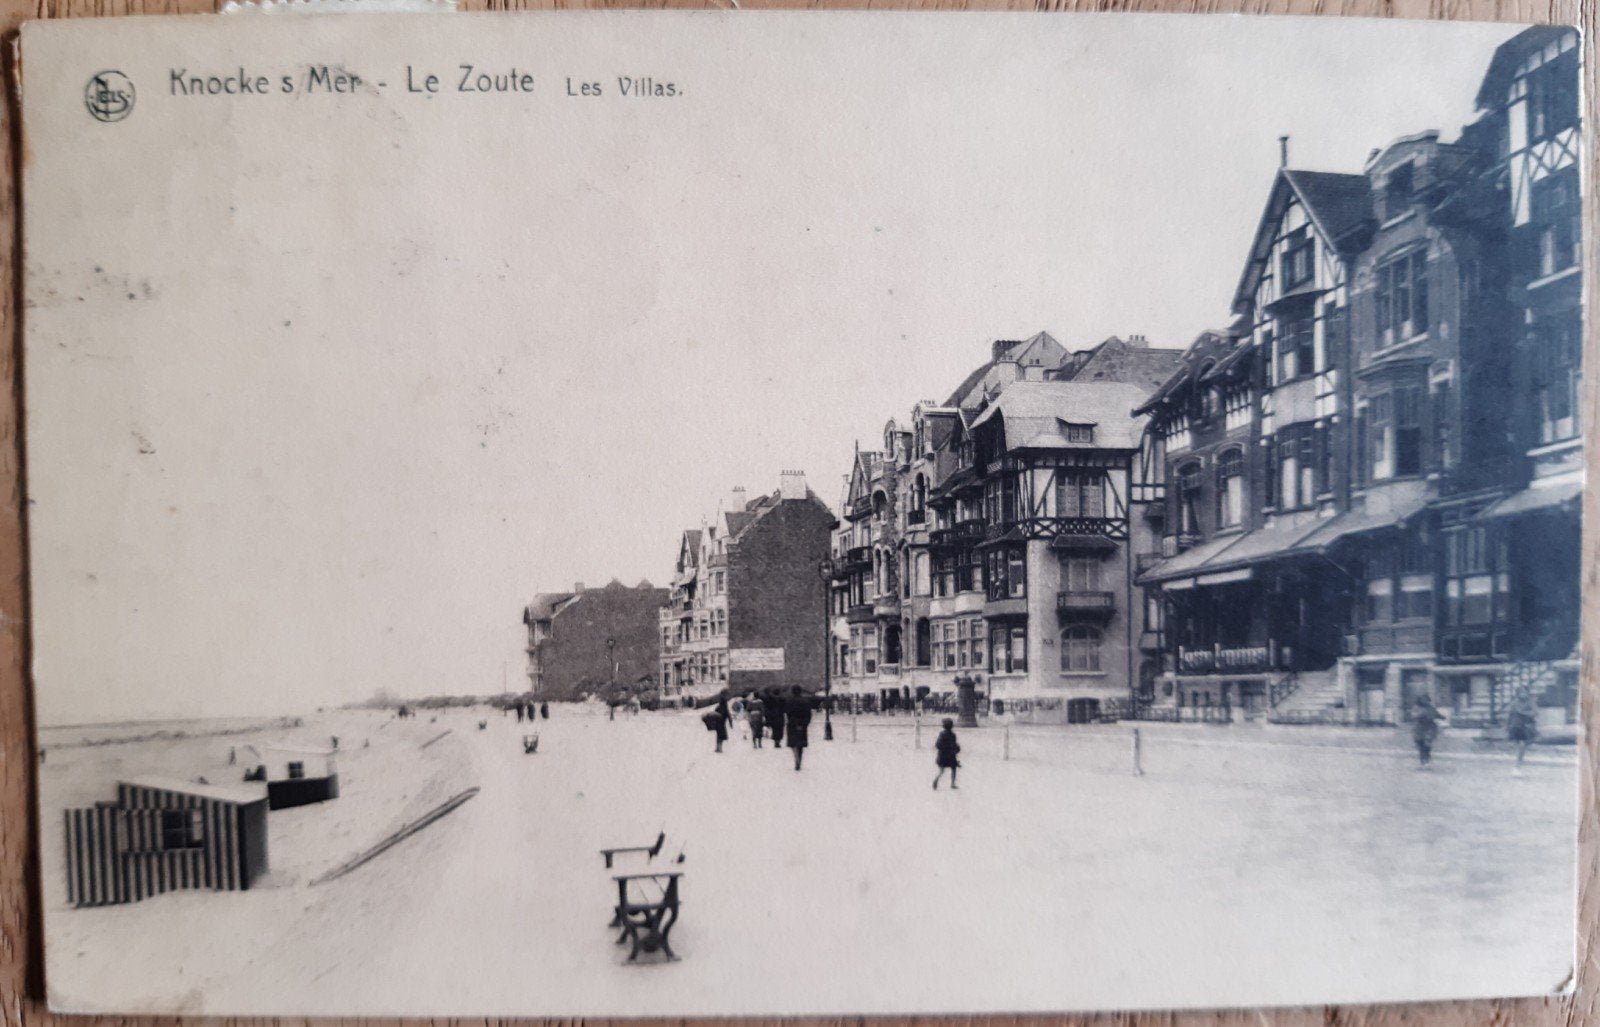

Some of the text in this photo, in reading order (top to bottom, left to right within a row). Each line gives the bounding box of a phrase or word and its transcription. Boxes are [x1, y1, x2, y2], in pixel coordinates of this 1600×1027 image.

[169, 66, 270, 96] Knocke
[281, 75, 295, 93] s
[307, 65, 364, 93] Mer
[406, 64, 440, 93] Le
[457, 64, 535, 93] Zoute
[565, 76, 603, 97] Les
[617, 76, 684, 97] Villas.
